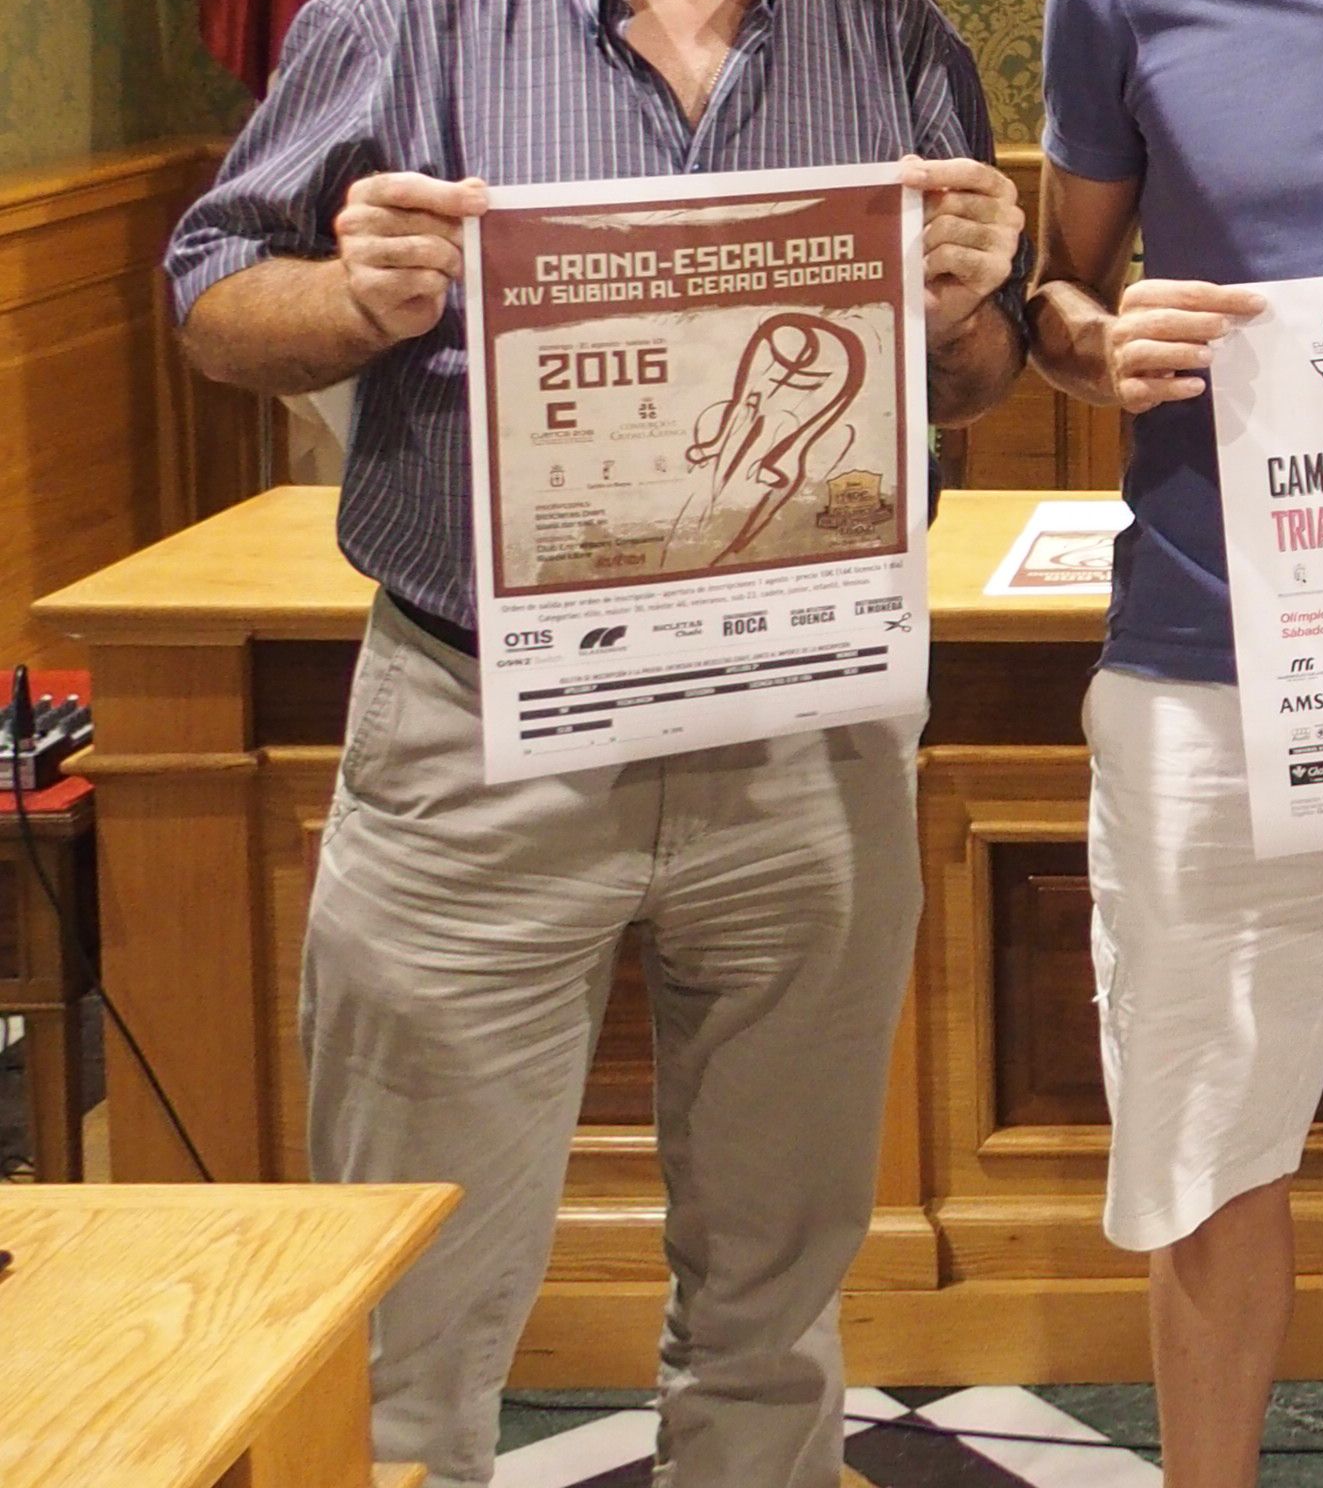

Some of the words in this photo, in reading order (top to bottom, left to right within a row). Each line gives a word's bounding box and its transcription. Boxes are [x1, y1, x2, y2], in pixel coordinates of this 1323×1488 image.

[535, 234, 855, 282] CRONO-ESCALADA
[503, 286, 544, 306] XIV
[551, 281, 643, 304] SUBIDA
[650, 280, 681, 299] AL
[687, 272, 767, 296] CERRO
[774, 261, 884, 288] SOCORRO
[538, 347, 668, 391] 2016
[723, 617, 768, 637] ROCA
[791, 611, 836, 627] CUENCA
[504, 628, 553, 647] OTIS
